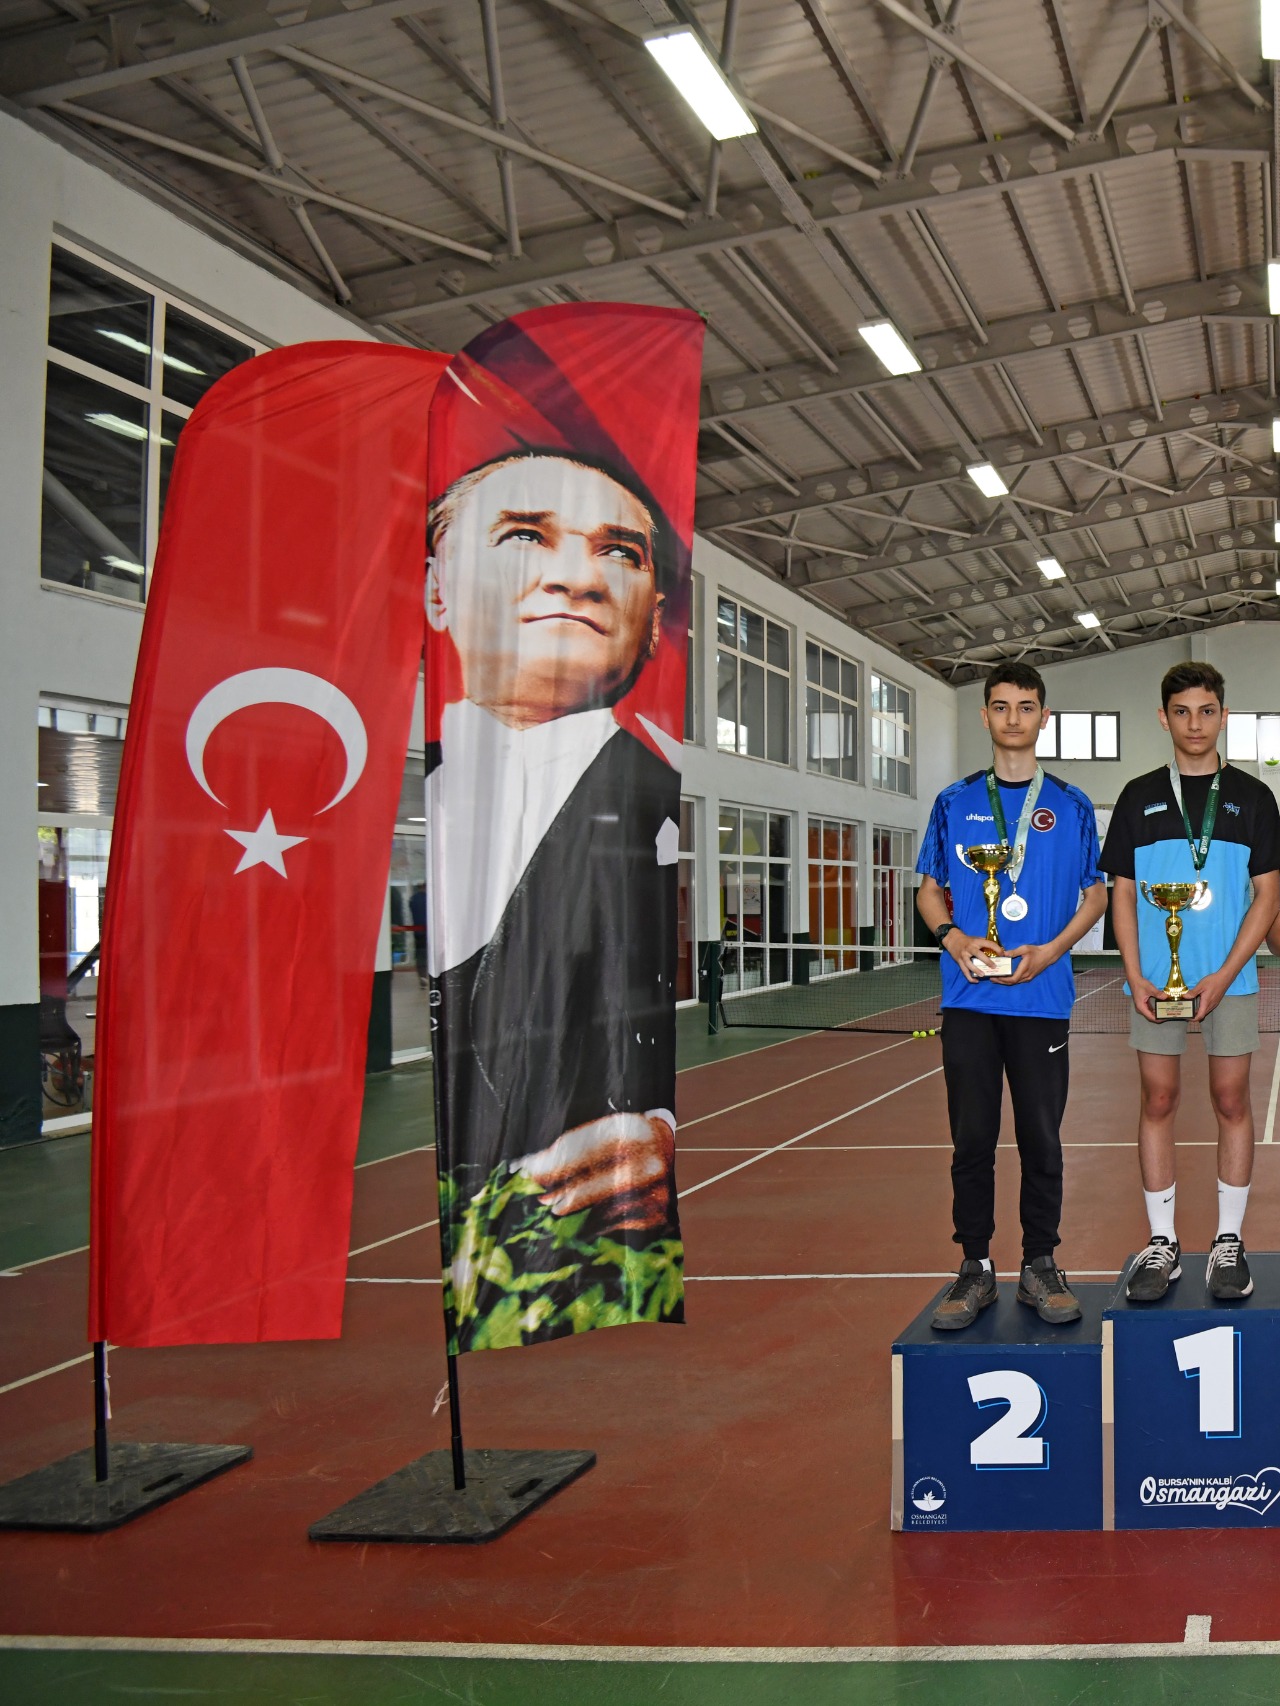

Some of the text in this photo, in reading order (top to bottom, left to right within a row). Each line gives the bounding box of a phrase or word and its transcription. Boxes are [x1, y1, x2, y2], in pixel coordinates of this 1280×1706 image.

[966, 813, 994, 822] uhlspor
[1173, 1326, 1241, 1439] 1
[967, 1370, 1049, 1470] 2
[1140, 1476, 1272, 1510] Osmangazi
[1158, 1476, 1232, 1486] BURSA'NIN KALBİ
